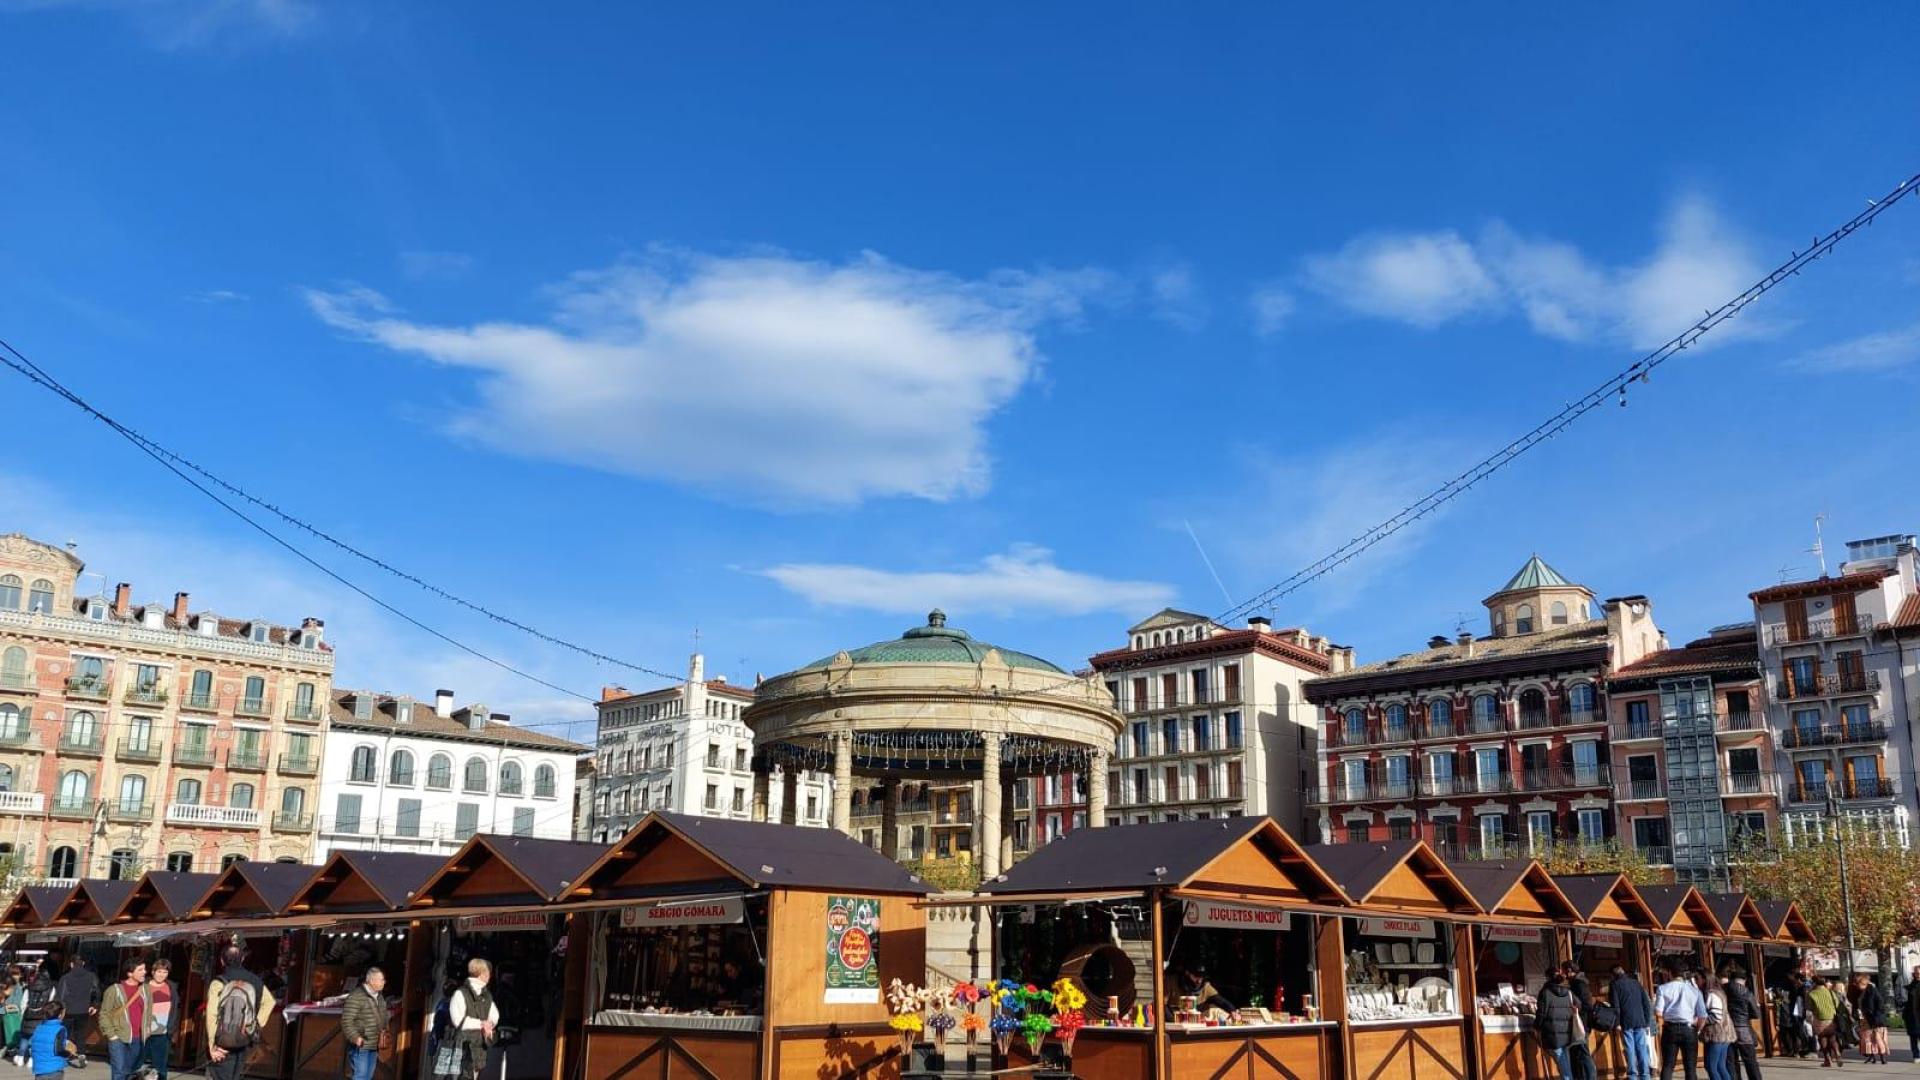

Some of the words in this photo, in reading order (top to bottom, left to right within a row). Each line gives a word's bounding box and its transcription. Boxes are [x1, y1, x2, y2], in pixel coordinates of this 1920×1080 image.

[706, 721, 753, 740] HOTEL
[648, 907, 682, 918] SERGIO
[683, 904, 726, 917] GOMARA
[1207, 907, 1253, 923] JUGUETES
